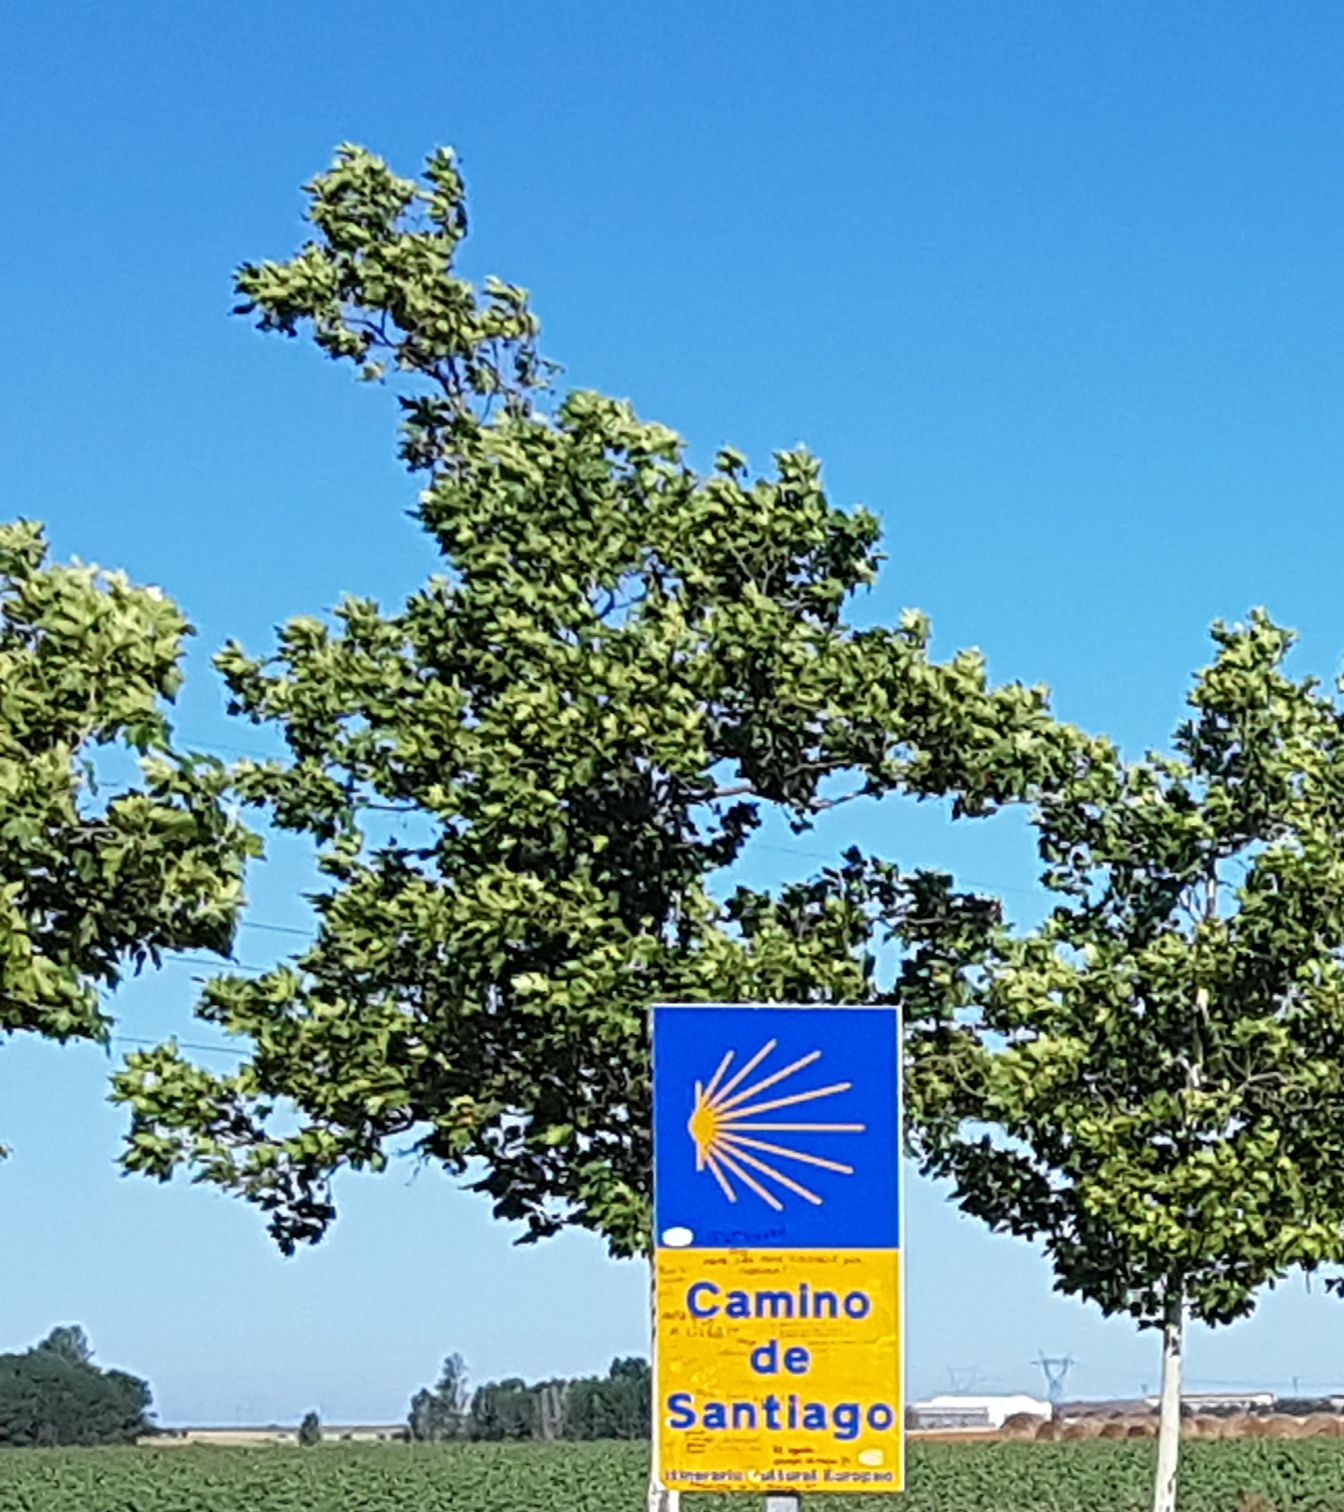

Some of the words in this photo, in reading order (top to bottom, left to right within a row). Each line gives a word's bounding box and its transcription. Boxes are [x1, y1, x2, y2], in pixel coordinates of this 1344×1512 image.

[686, 1281, 871, 1319] Camino
[749, 1339, 811, 1374] de
[666, 1392, 895, 1441] Santiago
